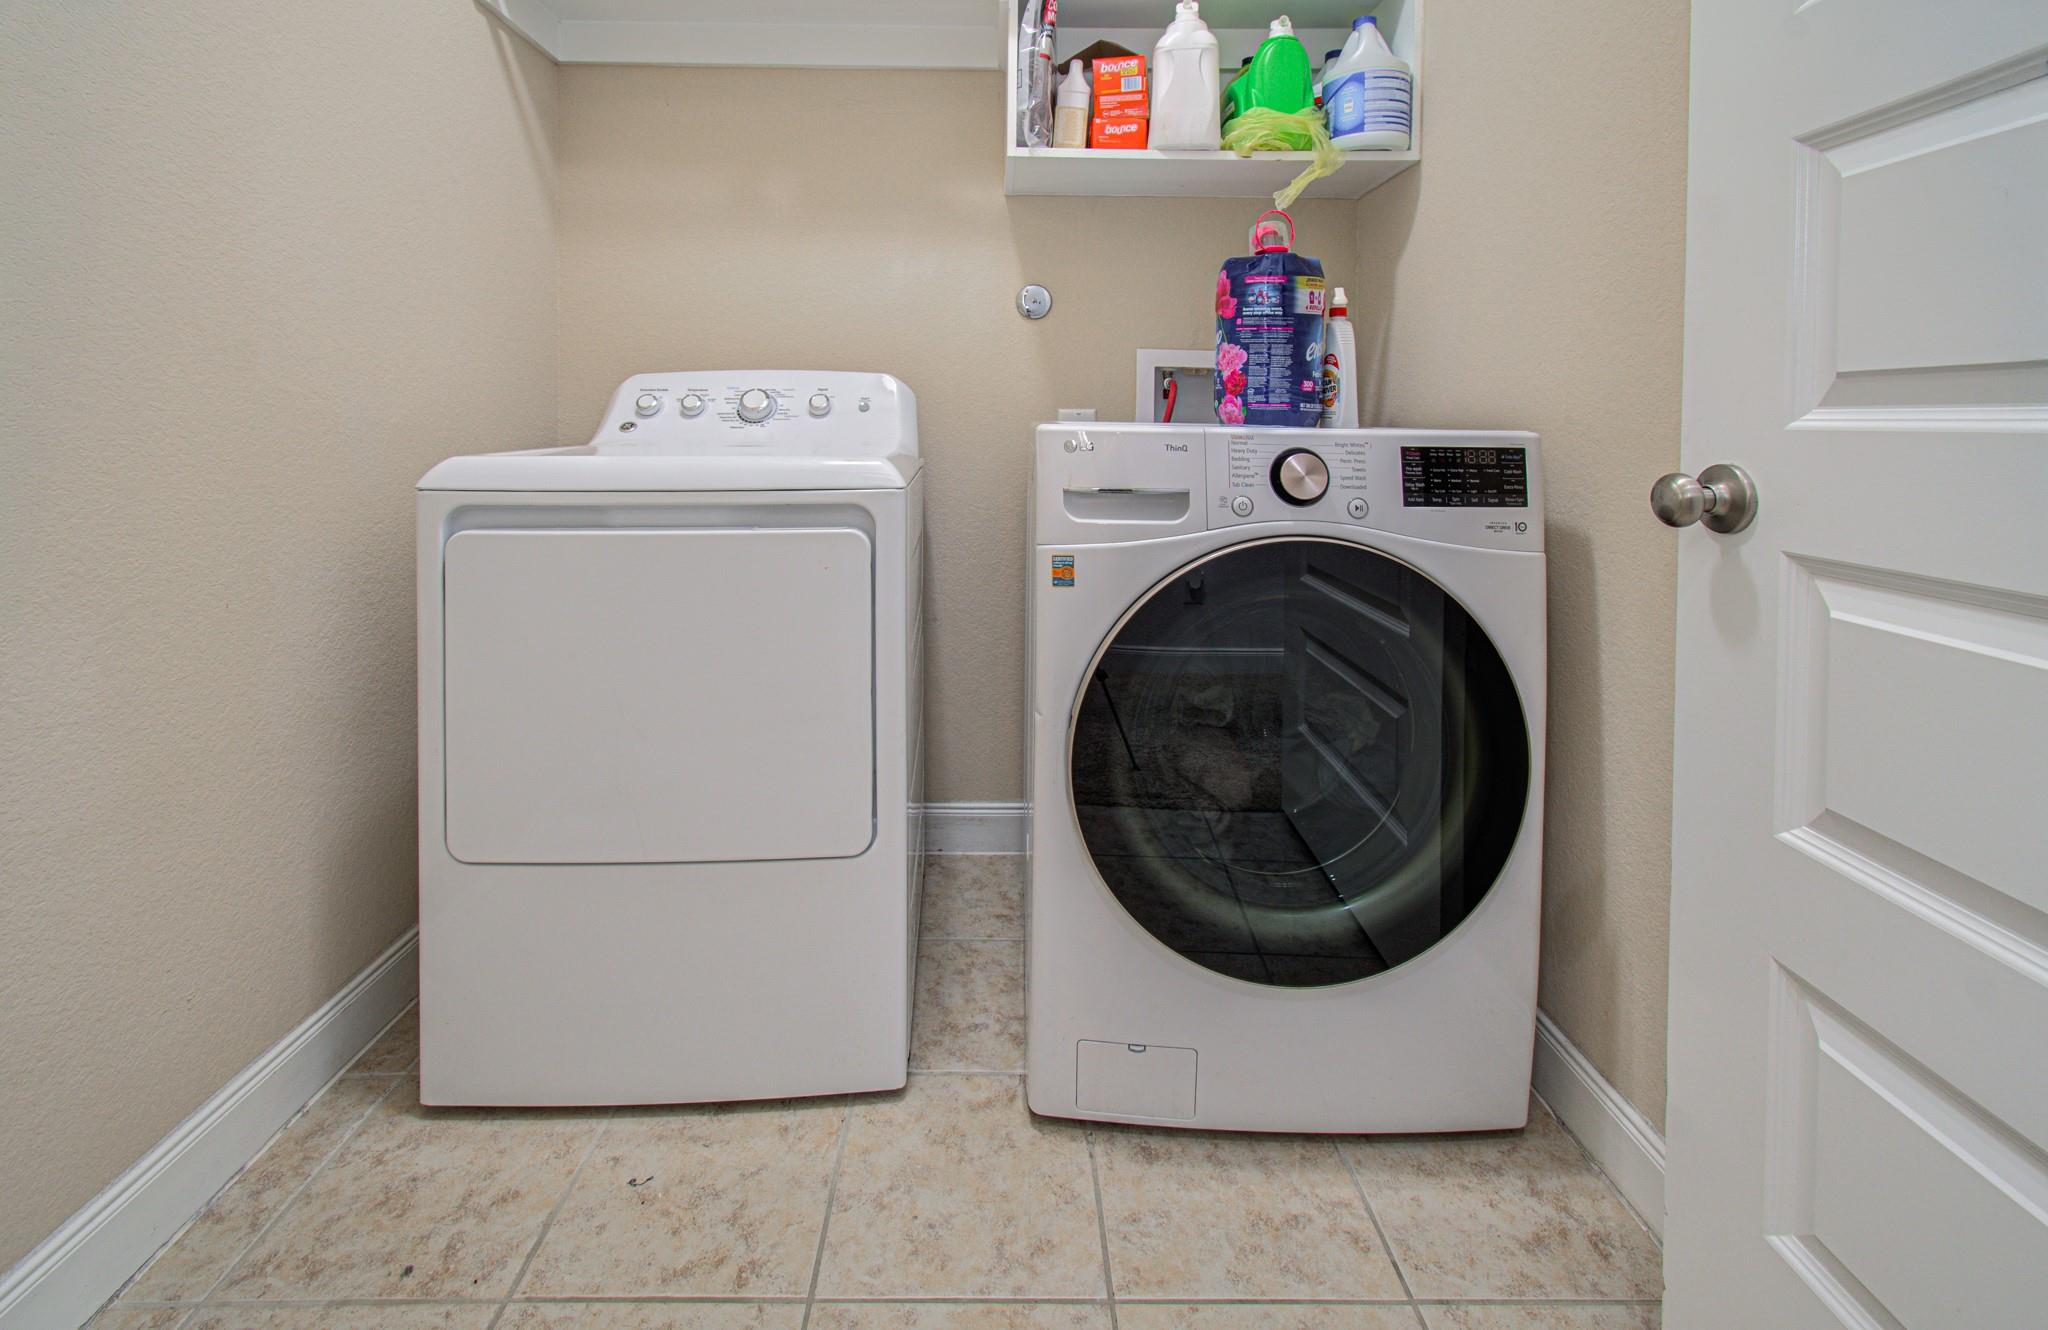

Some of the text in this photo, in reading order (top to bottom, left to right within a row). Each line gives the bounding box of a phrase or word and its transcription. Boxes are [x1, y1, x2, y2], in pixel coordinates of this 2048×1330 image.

[1100, 59, 1138, 73] bounce
[1105, 123, 1138, 135] bounce
[1165, 444, 1188, 452] ThinQ
